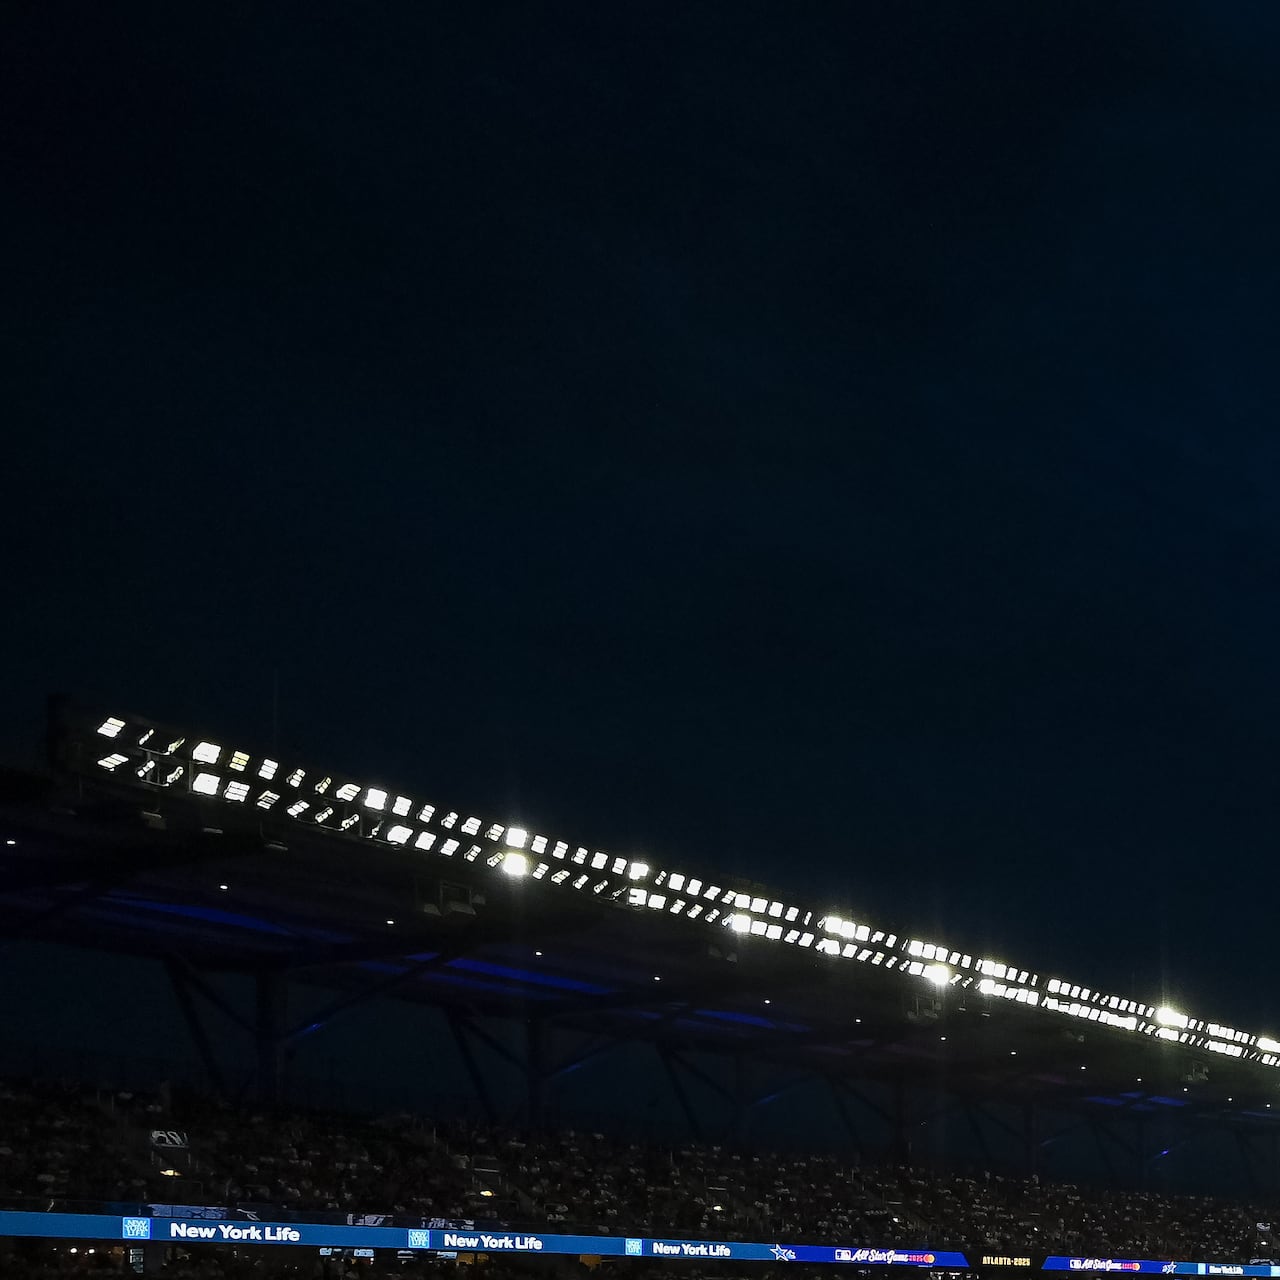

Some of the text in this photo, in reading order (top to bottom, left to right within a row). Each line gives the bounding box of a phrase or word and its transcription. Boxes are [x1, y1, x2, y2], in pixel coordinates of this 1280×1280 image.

[171, 1223, 300, 1241] New York Life
[444, 1234, 543, 1250] New York Life
